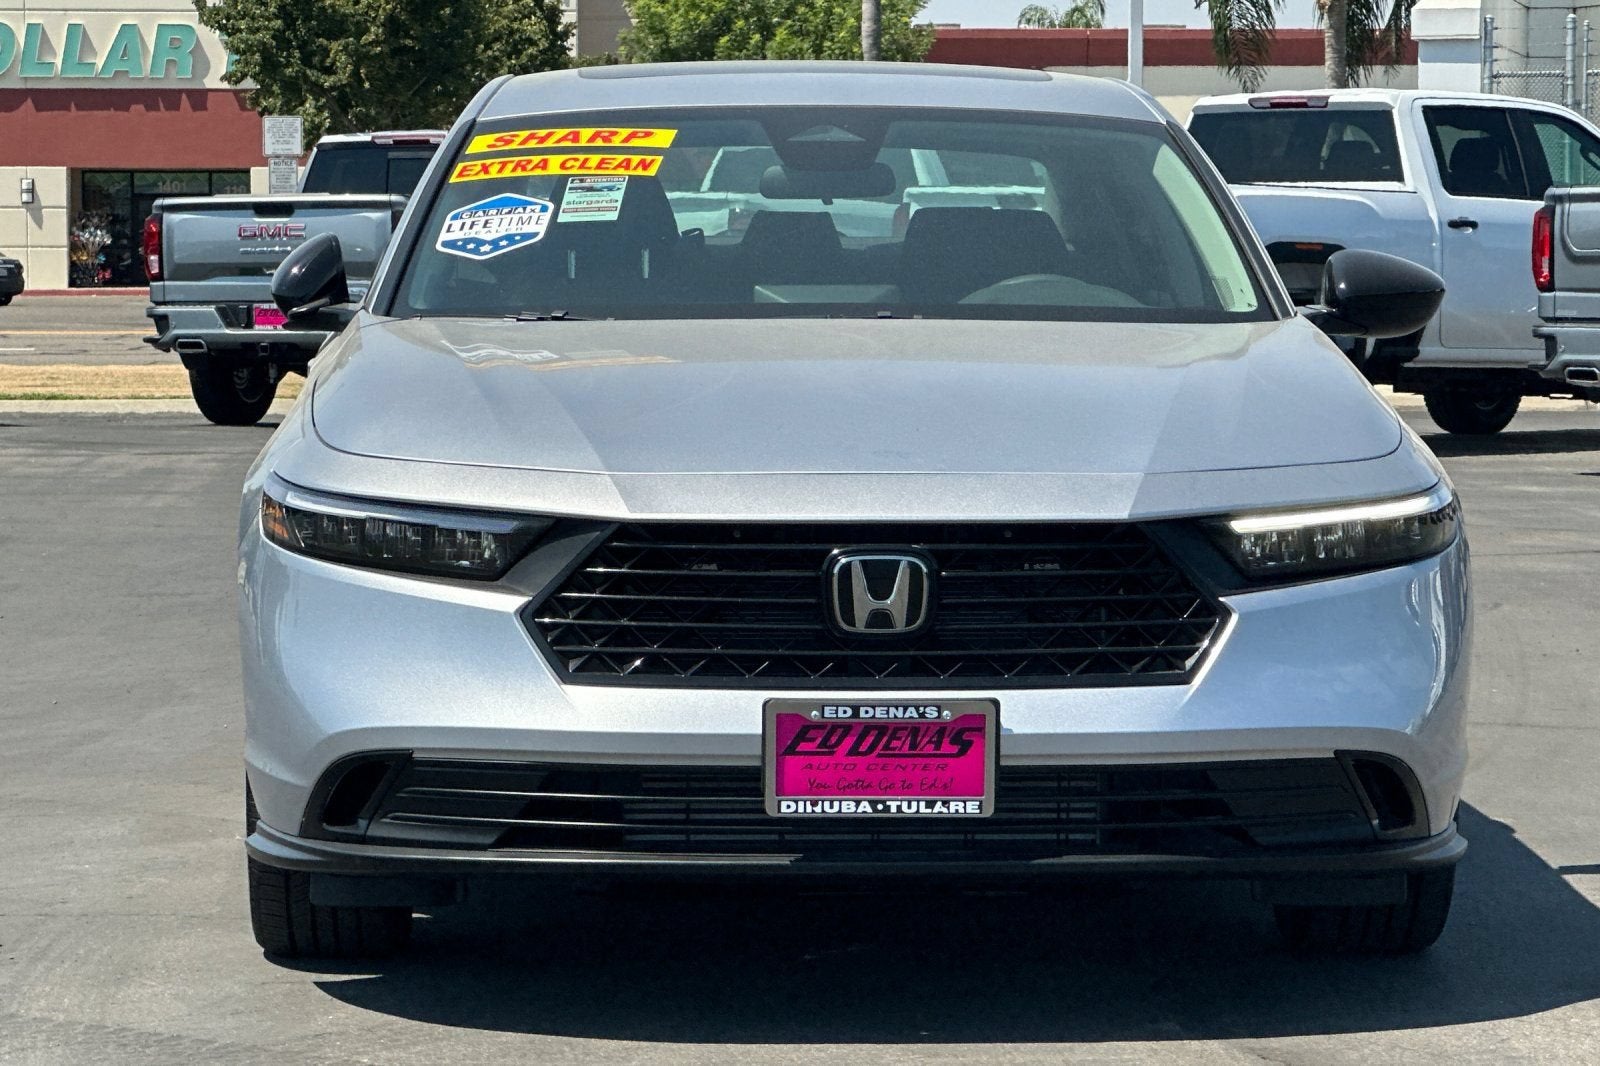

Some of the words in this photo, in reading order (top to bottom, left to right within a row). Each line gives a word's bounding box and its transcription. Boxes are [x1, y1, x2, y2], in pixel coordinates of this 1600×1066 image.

[486, 129, 656, 150] SHARP
[455, 157, 548, 179] EXTRA
[558, 157, 657, 172] CLEAN
[460, 205, 541, 221] CARFAX
[238, 223, 306, 239] GMC
[445, 214, 547, 234] LIFETIME
[463, 227, 523, 237] DEALER
[823, 706, 853, 719] ED
[859, 706, 939, 719] DENA'S
[779, 724, 854, 757] ED
[845, 724, 984, 758] DENA'S
[800, 762, 857, 771] AUTO
[866, 762, 949, 771] CENTER
[808, 777, 833, 791] You
[836, 776, 874, 792] Gotta
[878, 776, 896, 792] Go
[900, 778, 913, 790] to
[780, 800, 874, 814] DINUBA
[886, 800, 981, 814] TULARE
